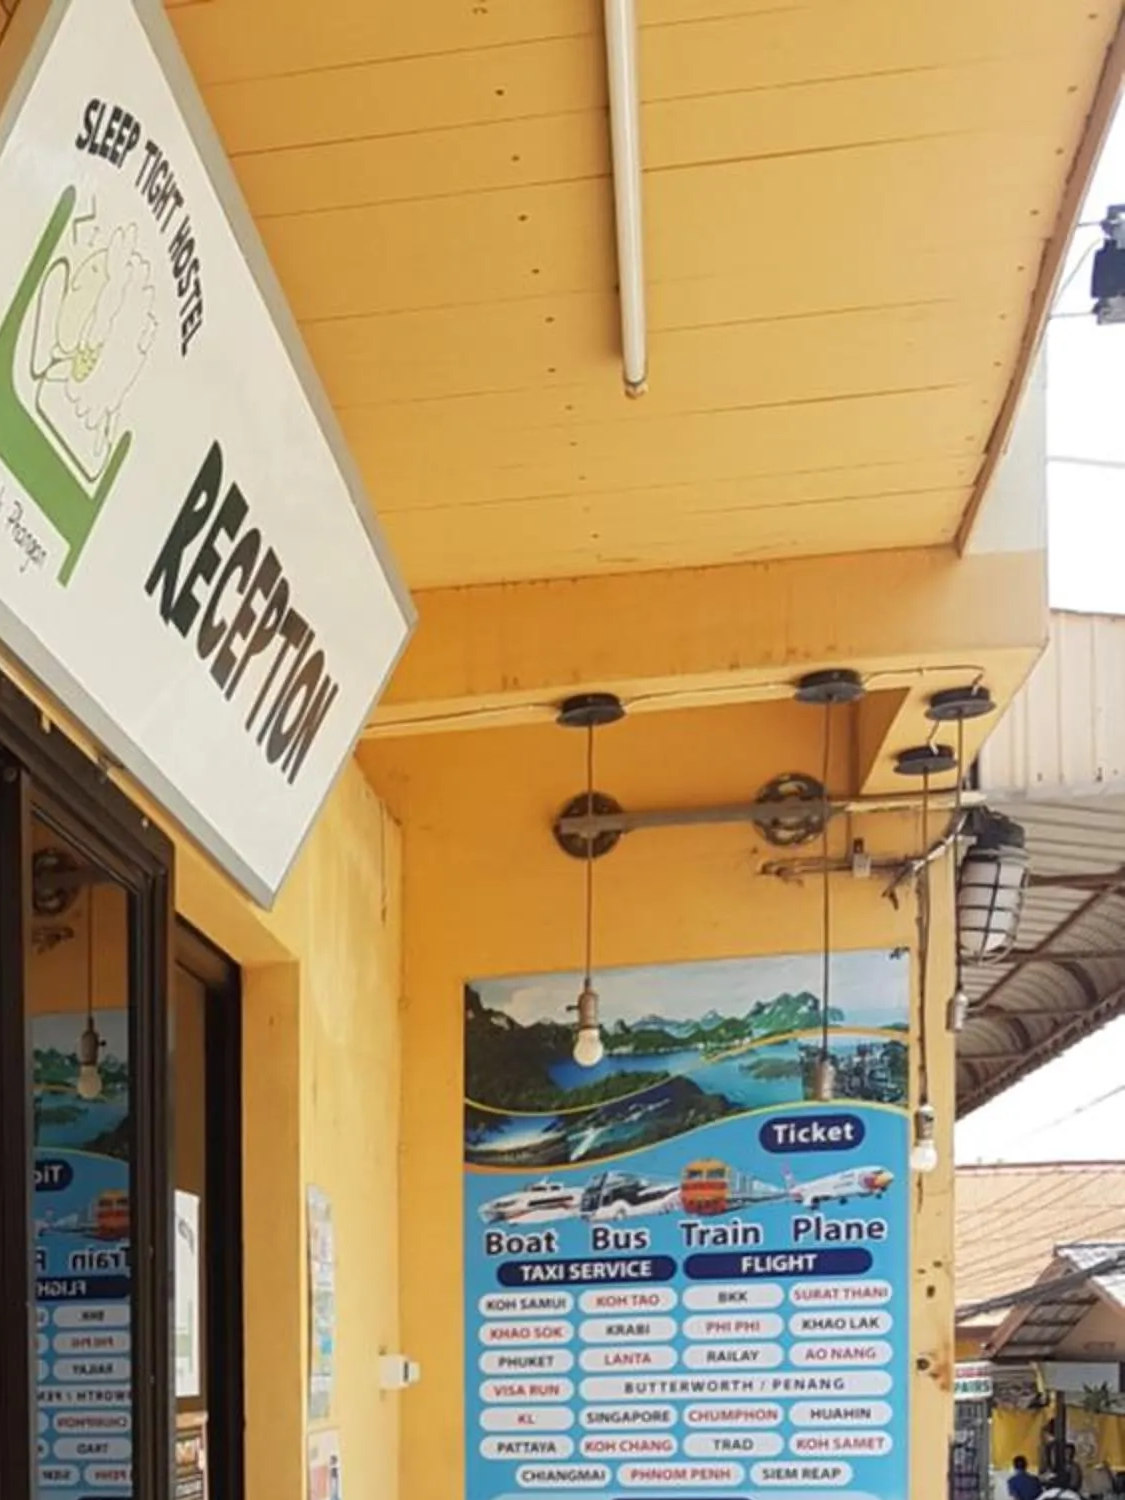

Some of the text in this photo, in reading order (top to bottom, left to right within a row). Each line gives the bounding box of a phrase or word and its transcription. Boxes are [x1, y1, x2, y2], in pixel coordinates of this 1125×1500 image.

[75, 98, 204, 357] SLEEP TIGHT HOSTEL
[144, 439, 339, 785] RECEPTION
[773, 1120, 855, 1147] Ticket
[486, 1215, 886, 1255] Boat Bus Train Plane
[741, 1254, 818, 1273] FLIGHT
[521, 1260, 653, 1282] TAXI SERVICE
[595, 1293, 660, 1307] KOH TAO
[718, 1290, 748, 1303] BKK
[794, 1287, 889, 1301] SURAT THANI
[486, 1298, 566, 1311] KOH SAMUI
[606, 1323, 650, 1336] KRABI
[705, 1320, 760, 1333] PHI PHI
[801, 1316, 880, 1330] KHAO LAK
[489, 1326, 564, 1339] KHAO SOK
[604, 1353, 651, 1366] LANTA
[706, 1350, 760, 1363] RAILAY
[805, 1347, 876, 1360] AO NANG
[498, 1355, 555, 1368] PHUKET
[493, 1384, 560, 1397] VISA RUN
[624, 1378, 754, 1395] BUTTERWORTH
[772, 1377, 845, 1391] PENANG
[517, 1413, 536, 1424] KL
[586, 1410, 670, 1424] SINGAPORE
[688, 1408, 778, 1421] CHUMPHON
[810, 1407, 871, 1420] HUAHIN
[497, 1441, 556, 1454] PATTAYA
[585, 1439, 673, 1452] KOH CHANG
[713, 1438, 754, 1451] TRAD
[796, 1436, 885, 1450] KOH SAMET
[521, 1469, 606, 1482] CHIANGMAI
[630, 1467, 731, 1481] PHNOM PENH
[762, 1467, 841, 1480] SIEM REAP
